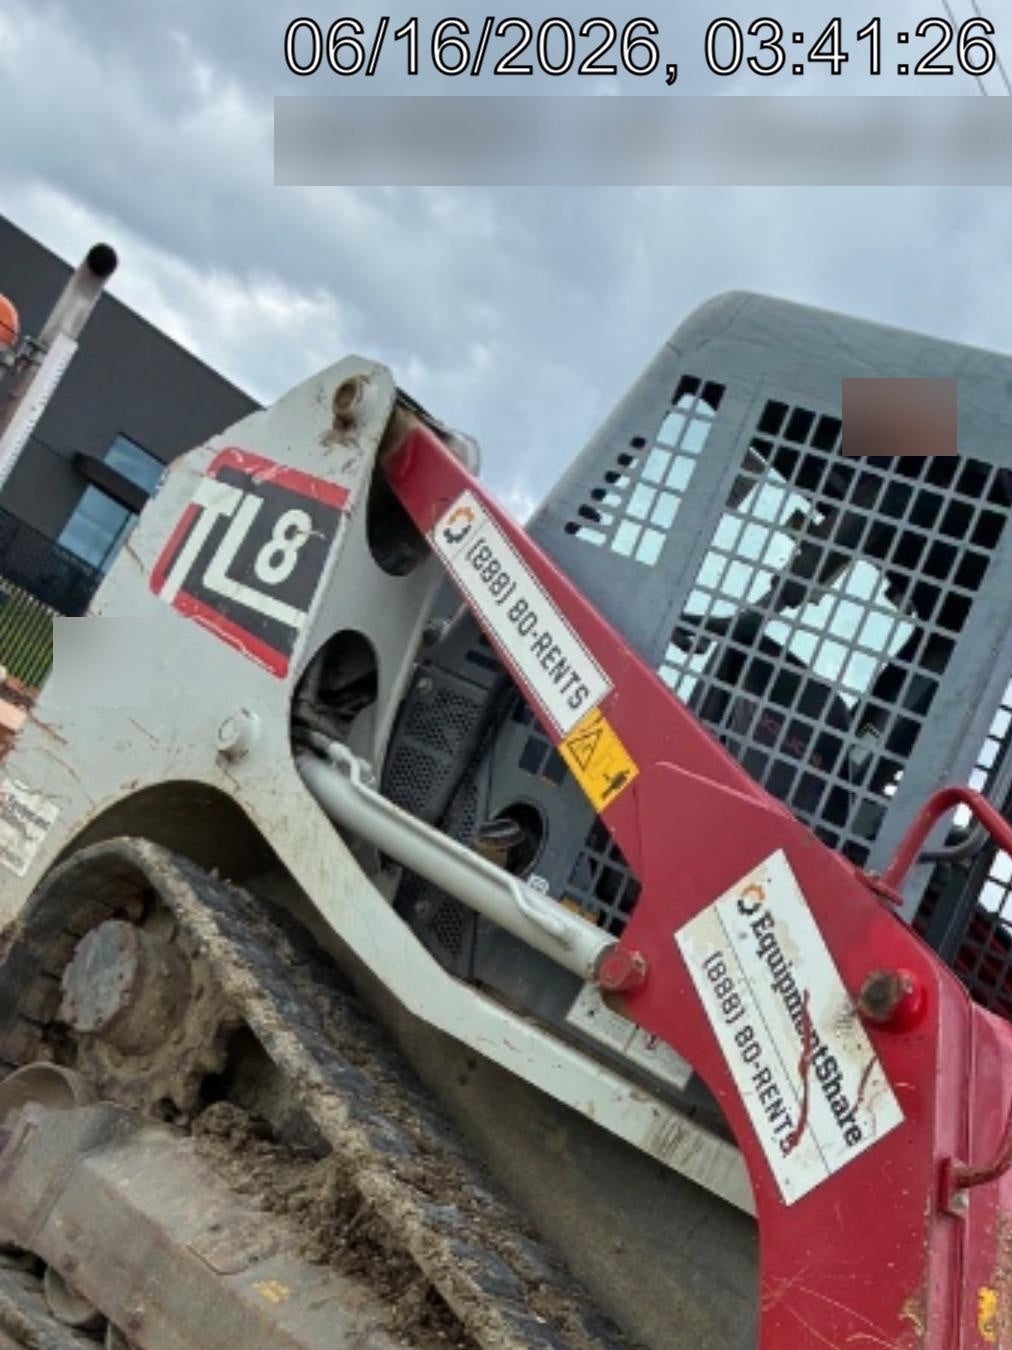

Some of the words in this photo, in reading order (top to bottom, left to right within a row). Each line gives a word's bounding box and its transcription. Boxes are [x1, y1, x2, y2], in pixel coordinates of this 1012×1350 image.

[465, 538, 517, 606] (888)
[507, 597, 591, 710] 80-RENTS
[702, 951, 746, 1024] (888)
